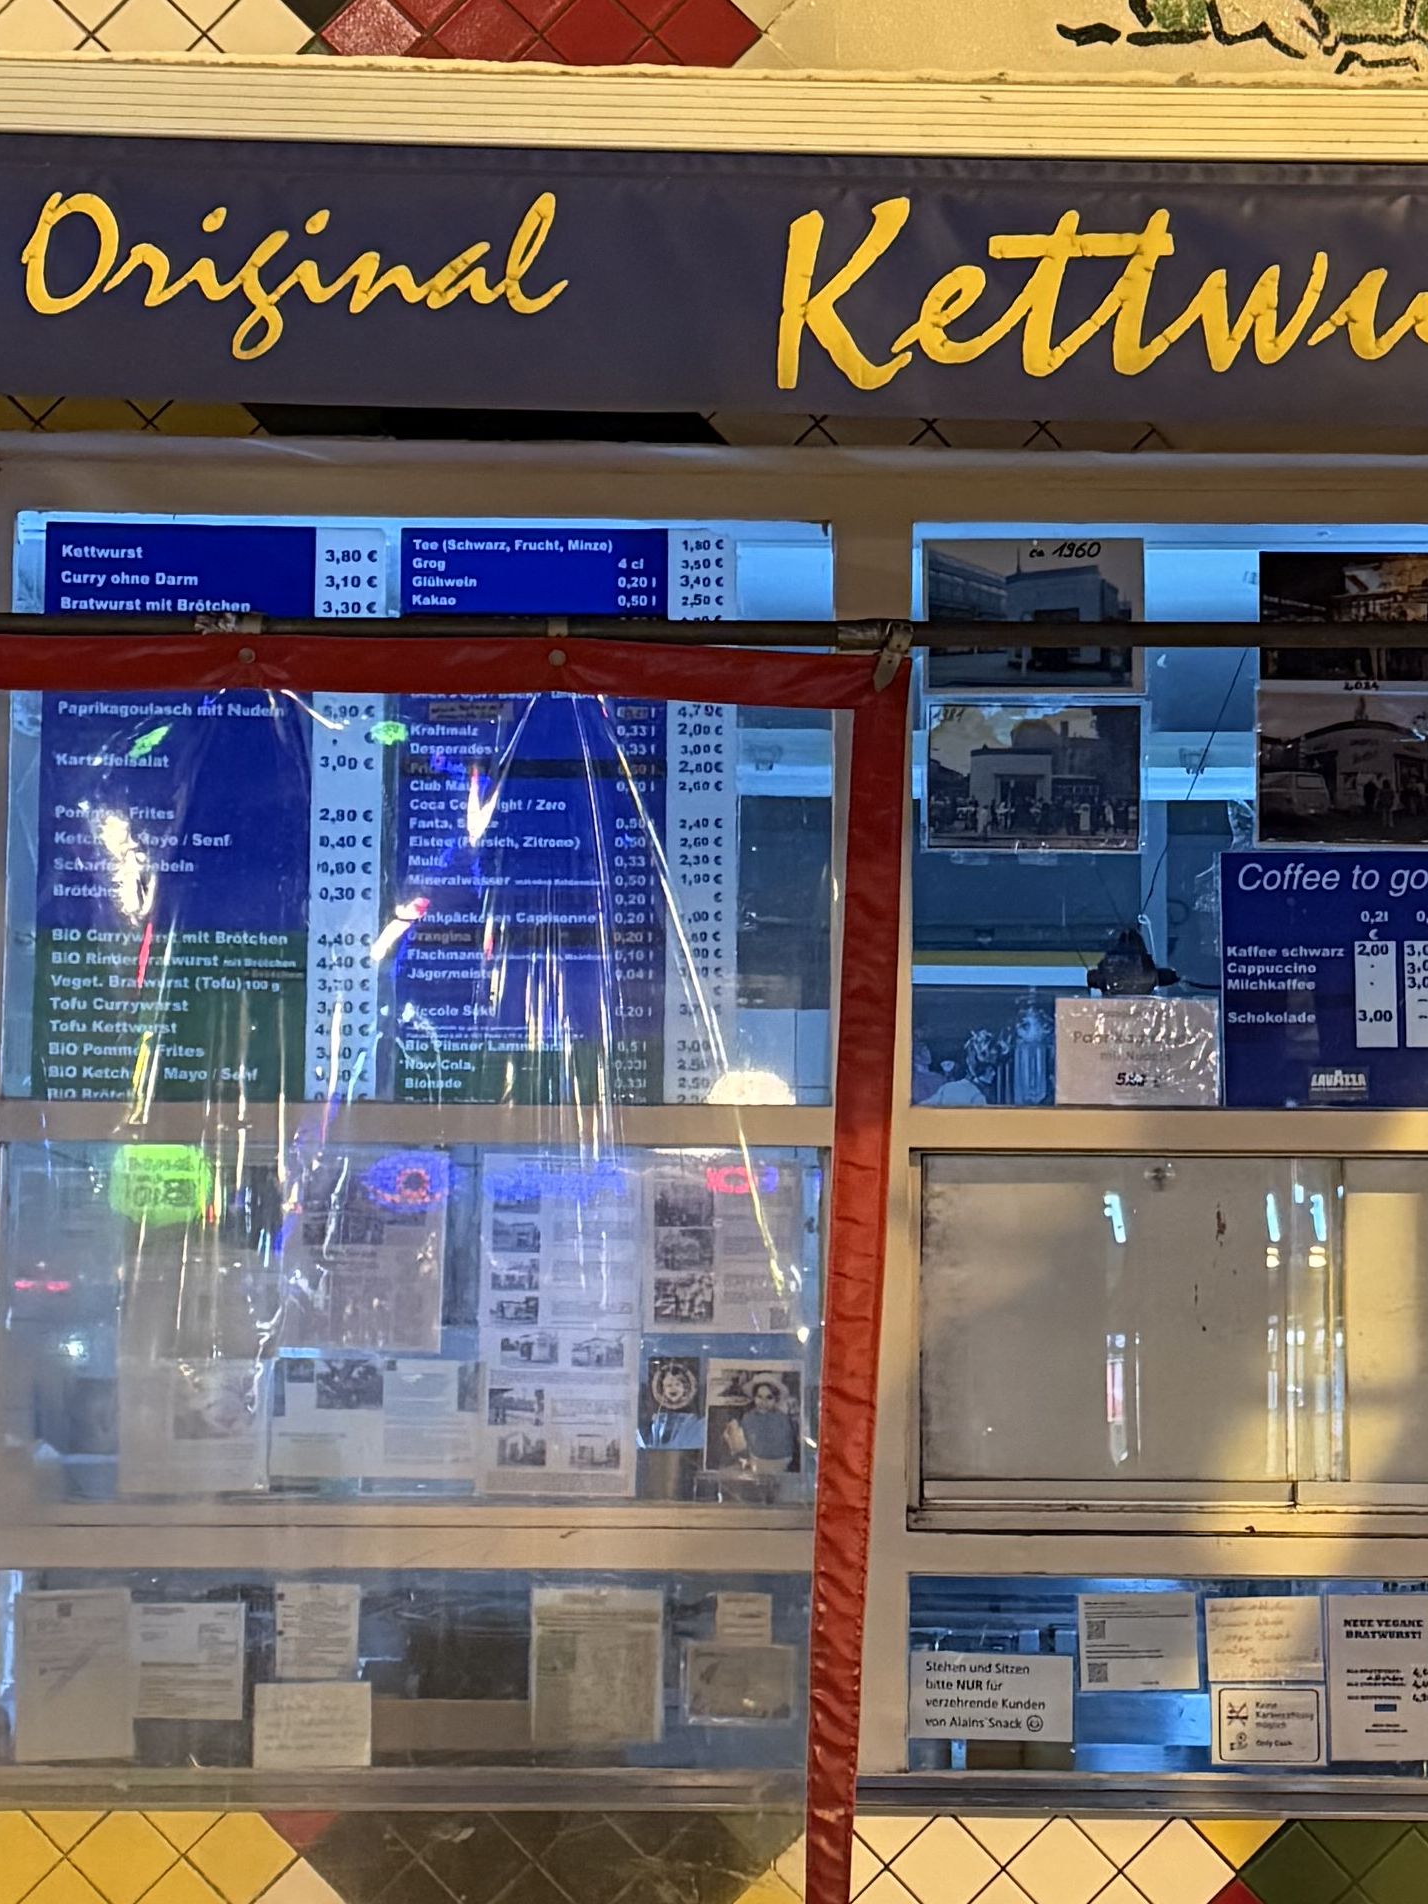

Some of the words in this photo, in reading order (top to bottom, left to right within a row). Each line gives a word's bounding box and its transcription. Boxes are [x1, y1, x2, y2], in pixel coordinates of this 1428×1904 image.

[18, 188, 571, 361] Original
[413, 538, 440, 552] Tee
[514, 538, 564, 553] Frucht,
[1052, 541, 1102, 558] 1960
[61, 543, 143, 560] Kettwurst
[325, 549, 362, 564] 3,80
[412, 557, 446, 572] Grog
[617, 558, 628, 570] 4
[60, 570, 107, 587] Curry
[110, 570, 150, 585] ohne
[155, 571, 198, 586] Darm
[325, 575, 362, 590] 3,10
[412, 575, 477, 589] Glühwein
[617, 576, 648, 590] 0,20
[60, 596, 142, 612] Bratwurst
[146, 597, 174, 612] mit
[177, 598, 251, 614] Brötchen
[322, 601, 362, 616] 3,30
[412, 594, 457, 607] Kakao
[617, 594, 648, 609] 0,50
[57, 700, 192, 719] Paprikagoulasch
[197, 703, 224, 718] mit
[409, 723, 480, 738] Kraftmalz
[616, 725, 647, 738] 0,33
[677, 722, 711, 738] 2,00
[319, 754, 358, 772] 3,00
[409, 780, 441, 793] Club
[409, 798, 446, 811] Coca
[535, 798, 567, 811] Zero
[129, 805, 175, 820] Frites
[318, 808, 358, 824] 2,80
[191, 832, 230, 847] Senf
[1237, 862, 1340, 891] Coffee
[1351, 864, 1380, 891] to
[318, 887, 357, 902] 0,30
[183, 929, 209, 944] mit
[215, 931, 288, 946] Brötchen
[316, 932, 355, 947] 4,40
[1226, 945, 1278, 958] Kaffee
[1281, 946, 1346, 958] schwarz
[1357, 944, 1390, 957] 2,00
[1226, 962, 1317, 976] Cappuccino
[50, 974, 104, 992] Veget.
[245, 980, 268, 991] 100
[1226, 978, 1316, 991] Milchkaffee
[49, 997, 87, 1012] Tofu
[1227, 1011, 1317, 1024] Schokolade
[1357, 1009, 1394, 1024] 3,00
[49, 1019, 87, 1034] Tofu
[163, 1067, 208, 1083] Mayo
[1376, 1618, 1425, 1629] VEGANE
[926, 1660, 967, 1673] Stehen
[969, 1661, 992, 1674] und
[995, 1662, 1030, 1675] Sitzen
[925, 1678, 953, 1691] bitte
[956, 1679, 983, 1691] NUR
[986, 1680, 1003, 1692] für
[925, 1696, 998, 1710] verzehrende
[1001, 1698, 1046, 1710] Kunden
[925, 1717, 947, 1728] von
